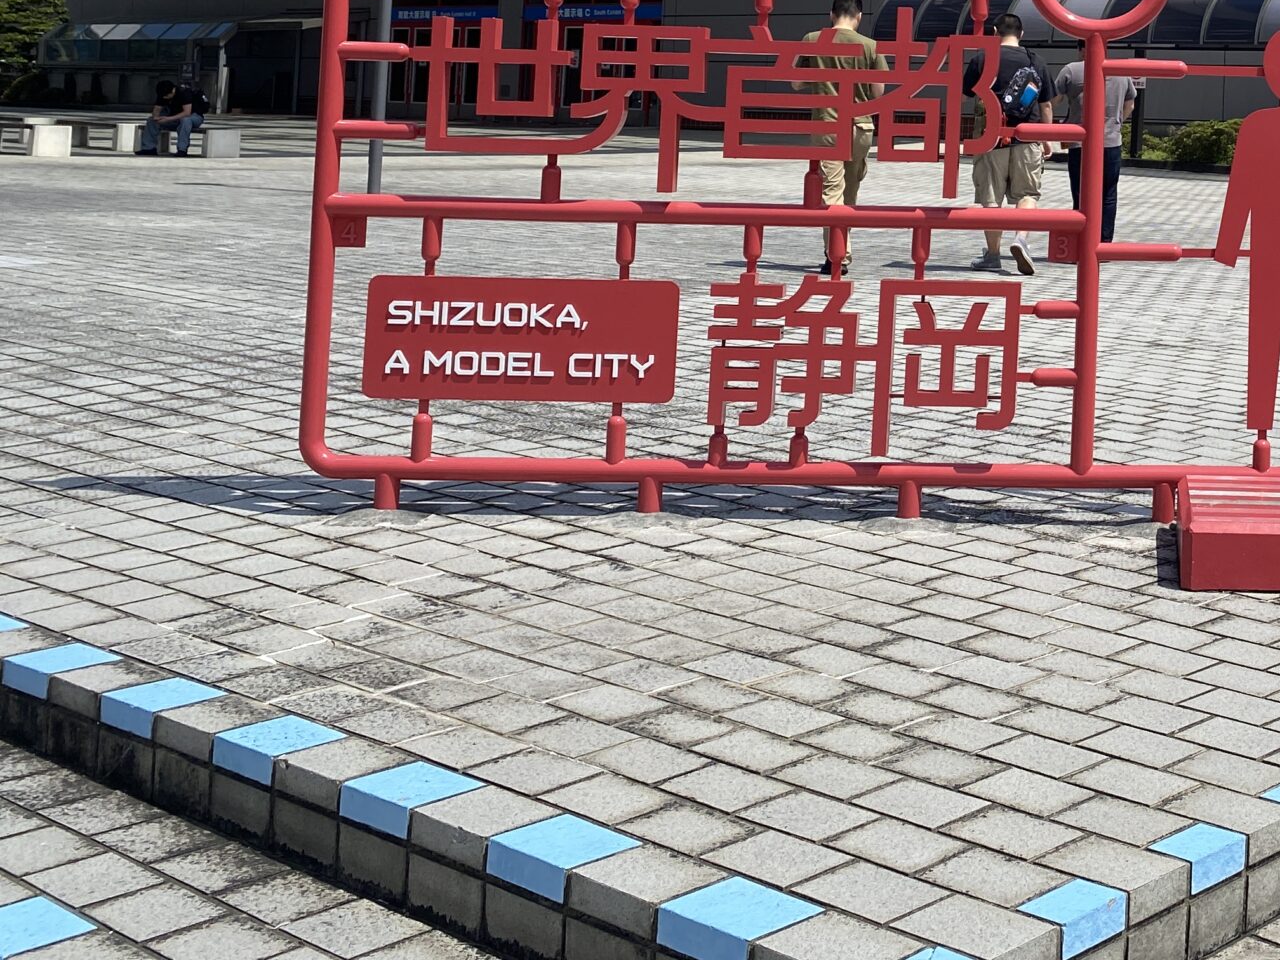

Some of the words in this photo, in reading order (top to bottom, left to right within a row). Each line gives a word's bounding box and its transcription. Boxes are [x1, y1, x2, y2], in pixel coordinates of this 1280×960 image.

[410, 6, 1003, 199] 世界首都
[340, 221, 357, 244] 4
[1055, 235, 1069, 259] 3
[387, 300, 589, 332] SHIZUOKA,
[384, 349, 410, 375] A
[422, 350, 554, 378] MODEL
[567, 352, 655, 379] CITY
[707, 272, 1022, 458] 静岡
